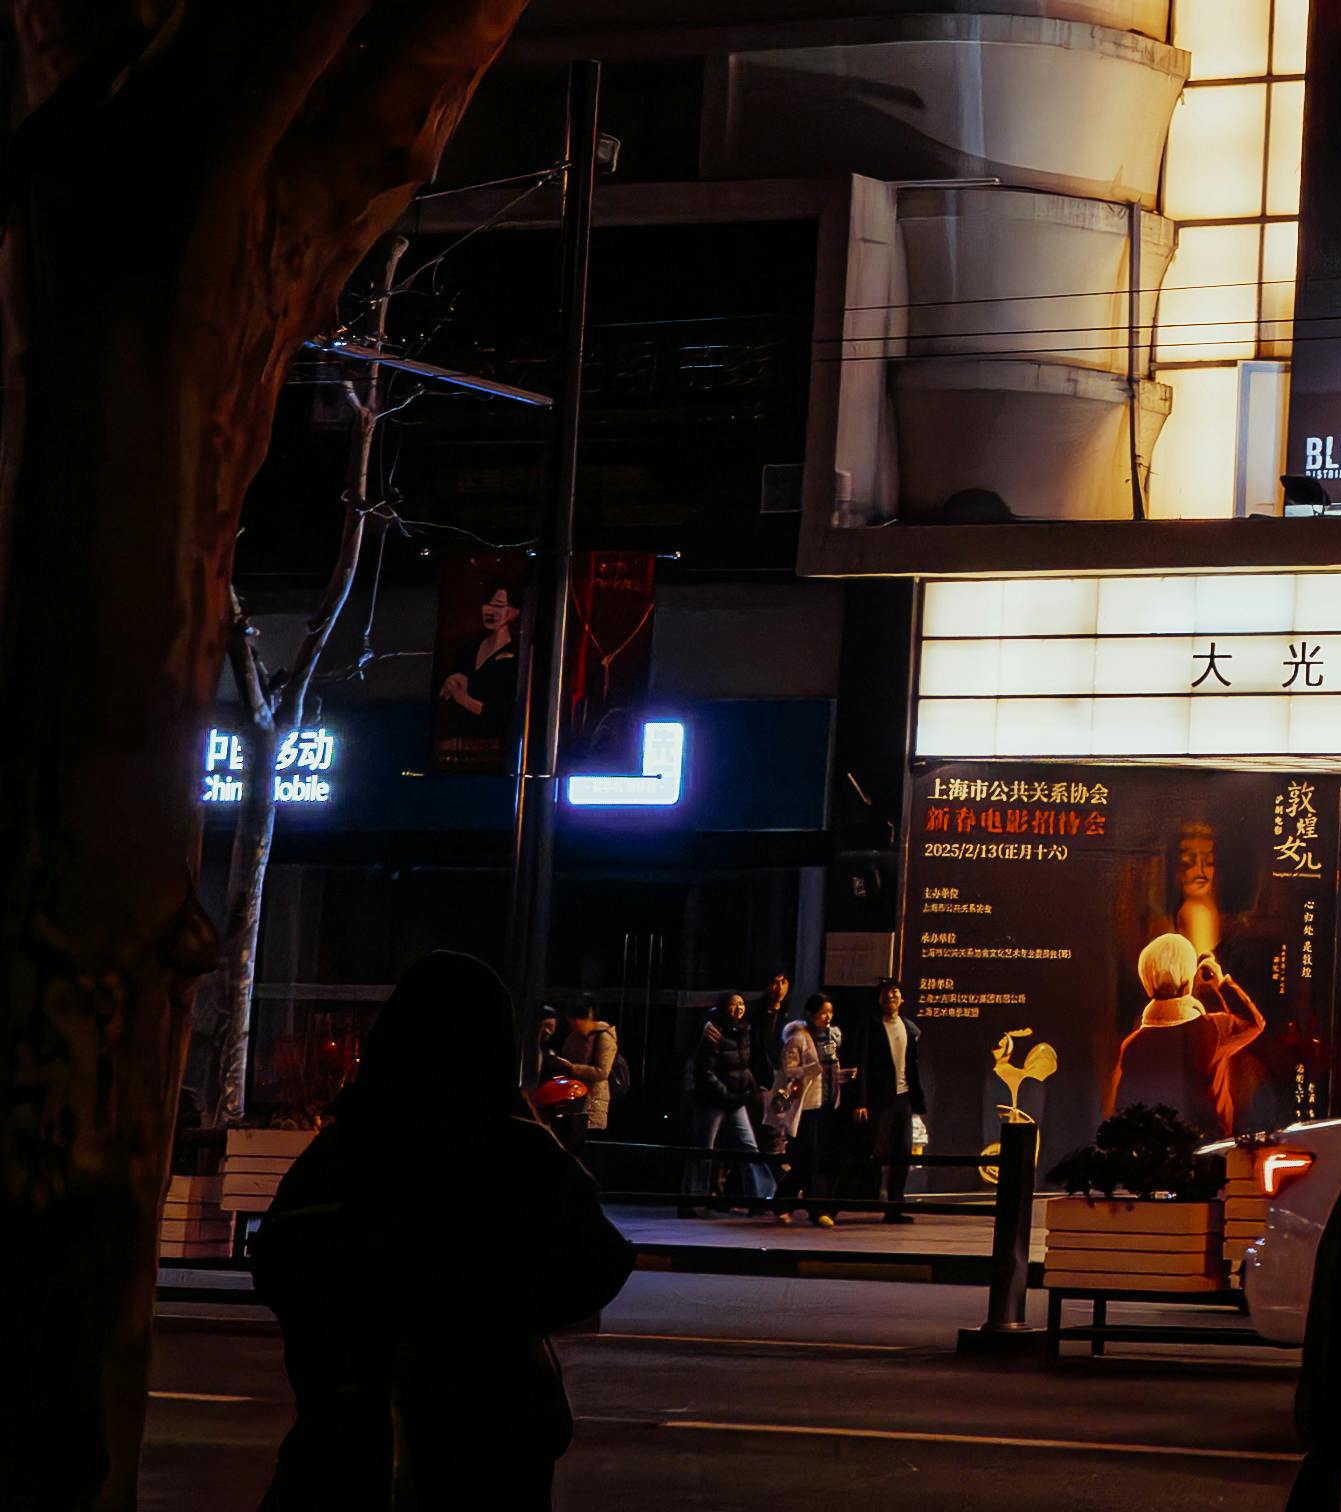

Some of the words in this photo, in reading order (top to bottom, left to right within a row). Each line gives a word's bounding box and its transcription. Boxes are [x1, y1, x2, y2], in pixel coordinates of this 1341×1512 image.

[927, 777, 1110, 805] 上海市公共关系协会
[924, 805, 1107, 836] 新春电影招待会
[1274, 780, 1322, 871] 敦煌女儿
[923, 887, 960, 900] 主办单位
